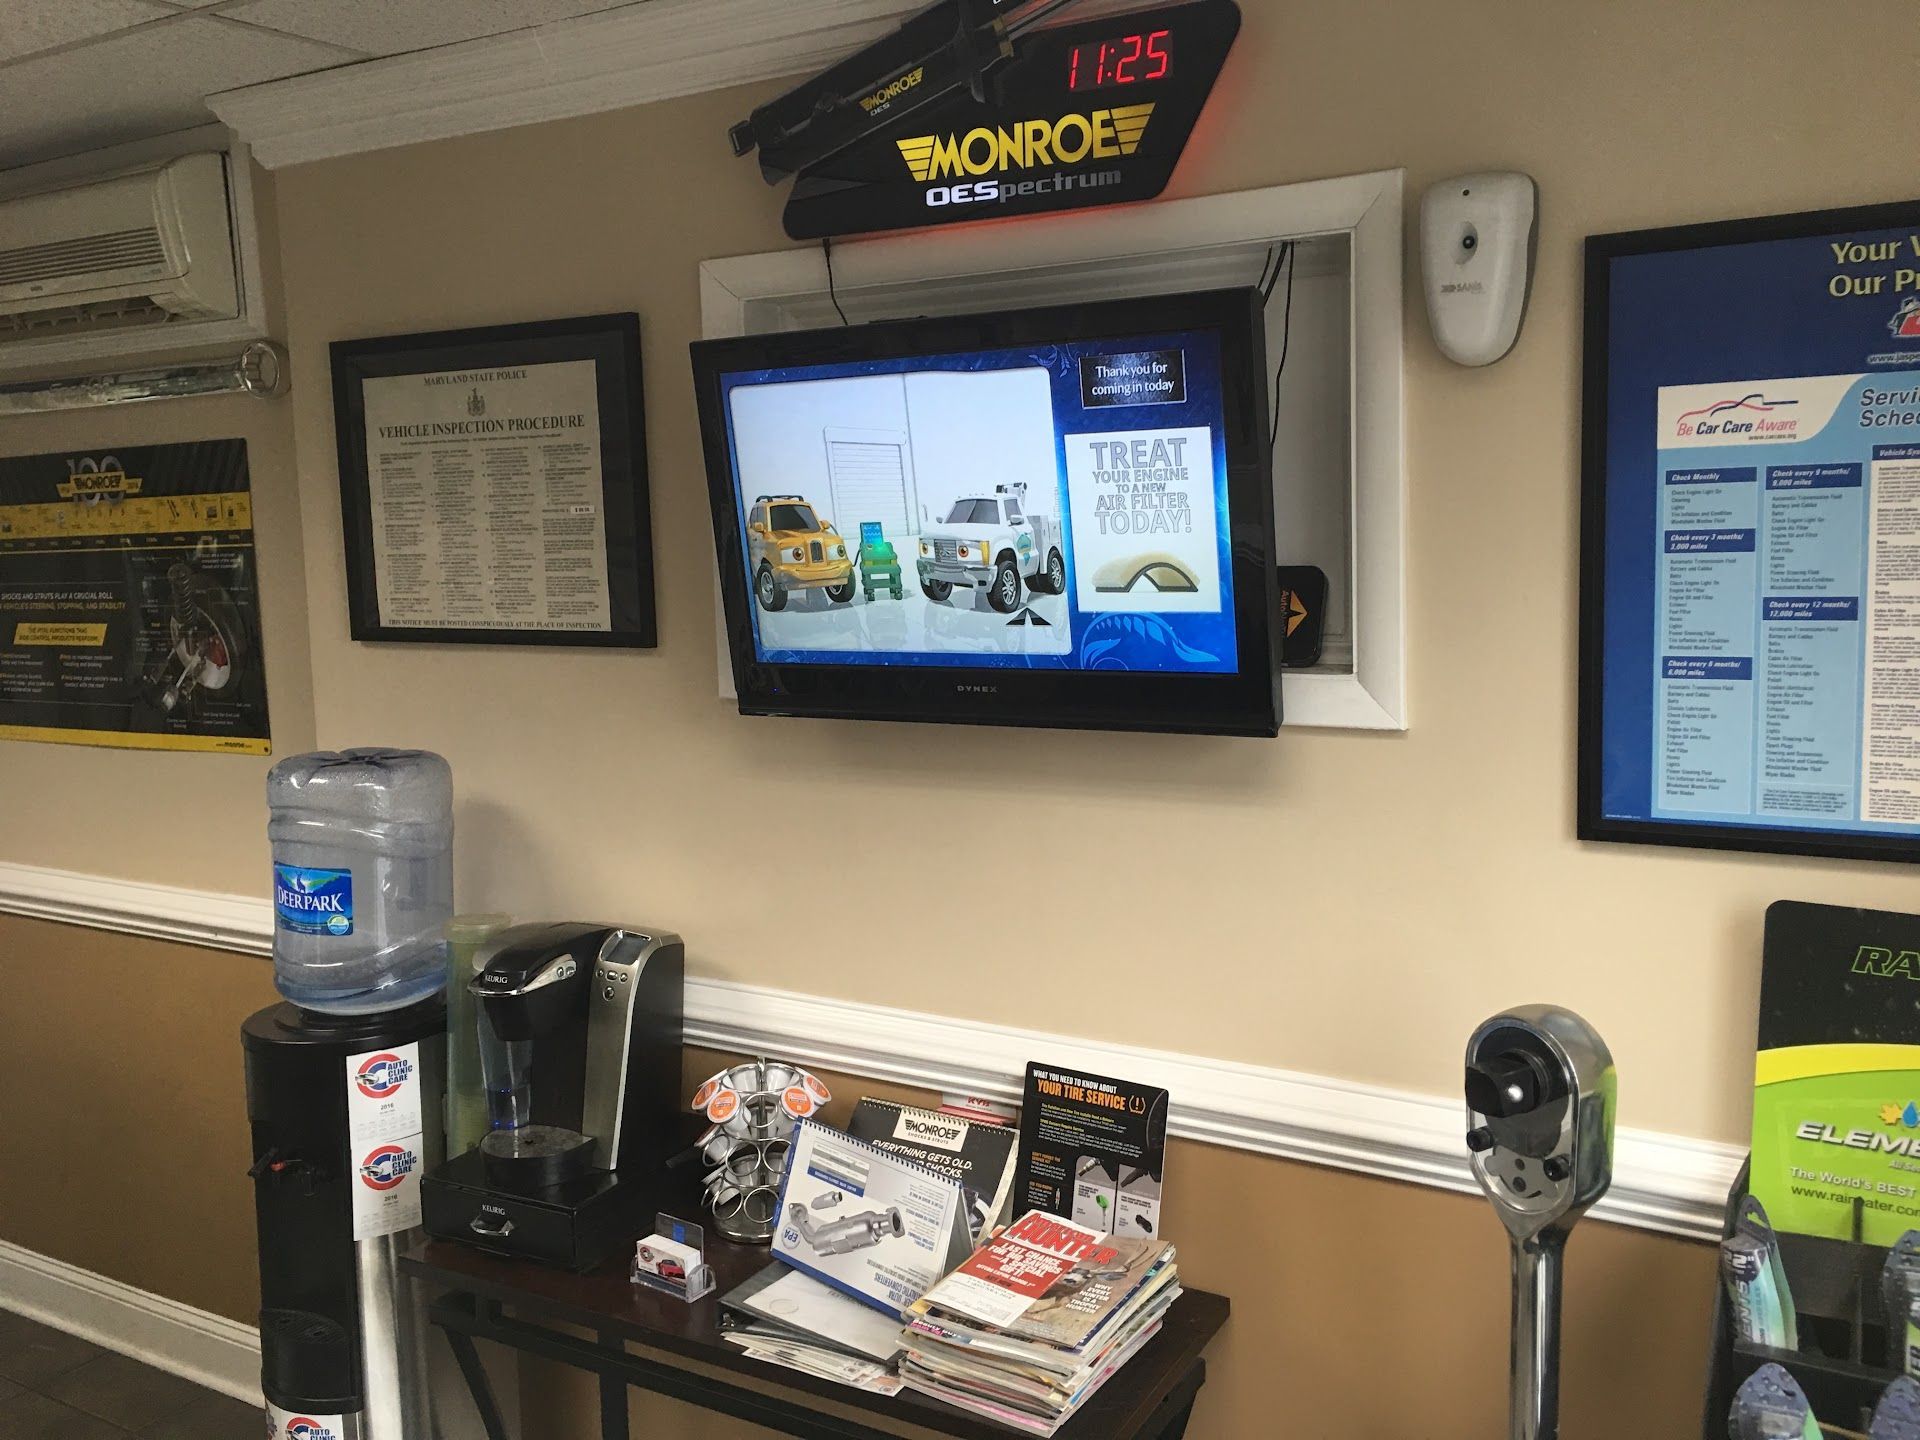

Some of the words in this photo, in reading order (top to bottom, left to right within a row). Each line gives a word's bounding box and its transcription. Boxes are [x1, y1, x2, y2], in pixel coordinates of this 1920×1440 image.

[1069, 29, 1169, 90] 11:25
[860, 67, 923, 111] MONROE
[905, 104, 1144, 181] MONROE
[925, 167, 1121, 207] OESpectrum
[1831, 241, 1902, 264] Your
[1829, 274, 1886, 297] Our
[424, 374, 468, 386] MARYLAND
[469, 372, 495, 384] STATE
[497, 369, 528, 381] POLICE
[1095, 364, 1129, 379] Thank
[1130, 366, 1150, 382] you
[1151, 362, 1168, 375] for
[1092, 381, 1131, 397] coming
[1132, 380, 1142, 393] in
[1144, 378, 1175, 395] today
[1861, 386, 1920, 407] Servi
[379, 423, 430, 439] VEHICLE
[432, 419, 504, 436] INSPECTION
[508, 414, 585, 432] PROCEDURE
[1677, 423, 1693, 436] Be
[1696, 421, 1720, 435] Car
[1722, 420, 1753, 433] Care
[1755, 418, 1797, 432] Aware
[1089, 437, 1187, 471] TREAT
[1092, 469, 1131, 484] YOUR
[1134, 467, 1189, 483] ENGINE
[1693, 472, 1720, 481] Monthly
[1116, 483, 1130, 494] TO
[1132, 483, 1140, 493] A
[1142, 482, 1166, 493] NEW
[1096, 494, 1128, 511] AIR
[1131, 492, 1189, 510] FILTER
[1094, 508, 1192, 535] TODAY!
[277, 886, 303, 910] DEER
[303, 893, 344, 912] PARK
[484, 974, 508, 984] KEURIG
[388, 1059, 408, 1071] AUTO
[388, 1065, 413, 1078] CLINIC
[388, 1073, 408, 1084] CARE
[1033, 1069, 1048, 1079] WHAT
[1049, 1072, 1060, 1082] YOU
[1060, 1075, 1074, 1085] NEED
[1074, 1078, 1081, 1086] TO
[1081, 1079, 1099, 1089] KNOW
[1099, 1083, 1118, 1094] ABOUT
[1037, 1079, 1062, 1096] YOUR
[1064, 1084, 1084, 1102] TIRE
[1086, 1089, 1127, 1111] SERVICE
[906, 1119, 959, 1140] MONROE
[392, 1150, 412, 1162] AUTO
[392, 1156, 417, 1169] CLINIC
[872, 1140, 927, 1159] EVERYTHING
[927, 1152, 951, 1166] GETS
[952, 1158, 973, 1170] OLD.
[392, 1165, 412, 1176] CARE
[1790, 1166, 1815, 1180] The
[1820, 1171, 1872, 1190] World's
[1877, 1182, 1917, 1197] BEST
[482, 1204, 505, 1216] KEURIG
[1791, 1186, 1920, 1217] www.rainater.co
[784, 1228, 798, 1243] EPA
[1001, 1242, 1027, 1255] LAST
[1025, 1251, 1062, 1266] CHANCE
[1010, 1260, 1046, 1277] SPECIAL
[1080, 1291, 1110, 1301] HUNTER
[1087, 1287, 1112, 1296] EVERY
[1095, 1283, 1113, 1292] WHY
[1066, 1303, 1097, 1314] HUNTER
[1070, 1299, 1101, 1310] TROPHY
[310, 1428, 330, 1436] AUTO
